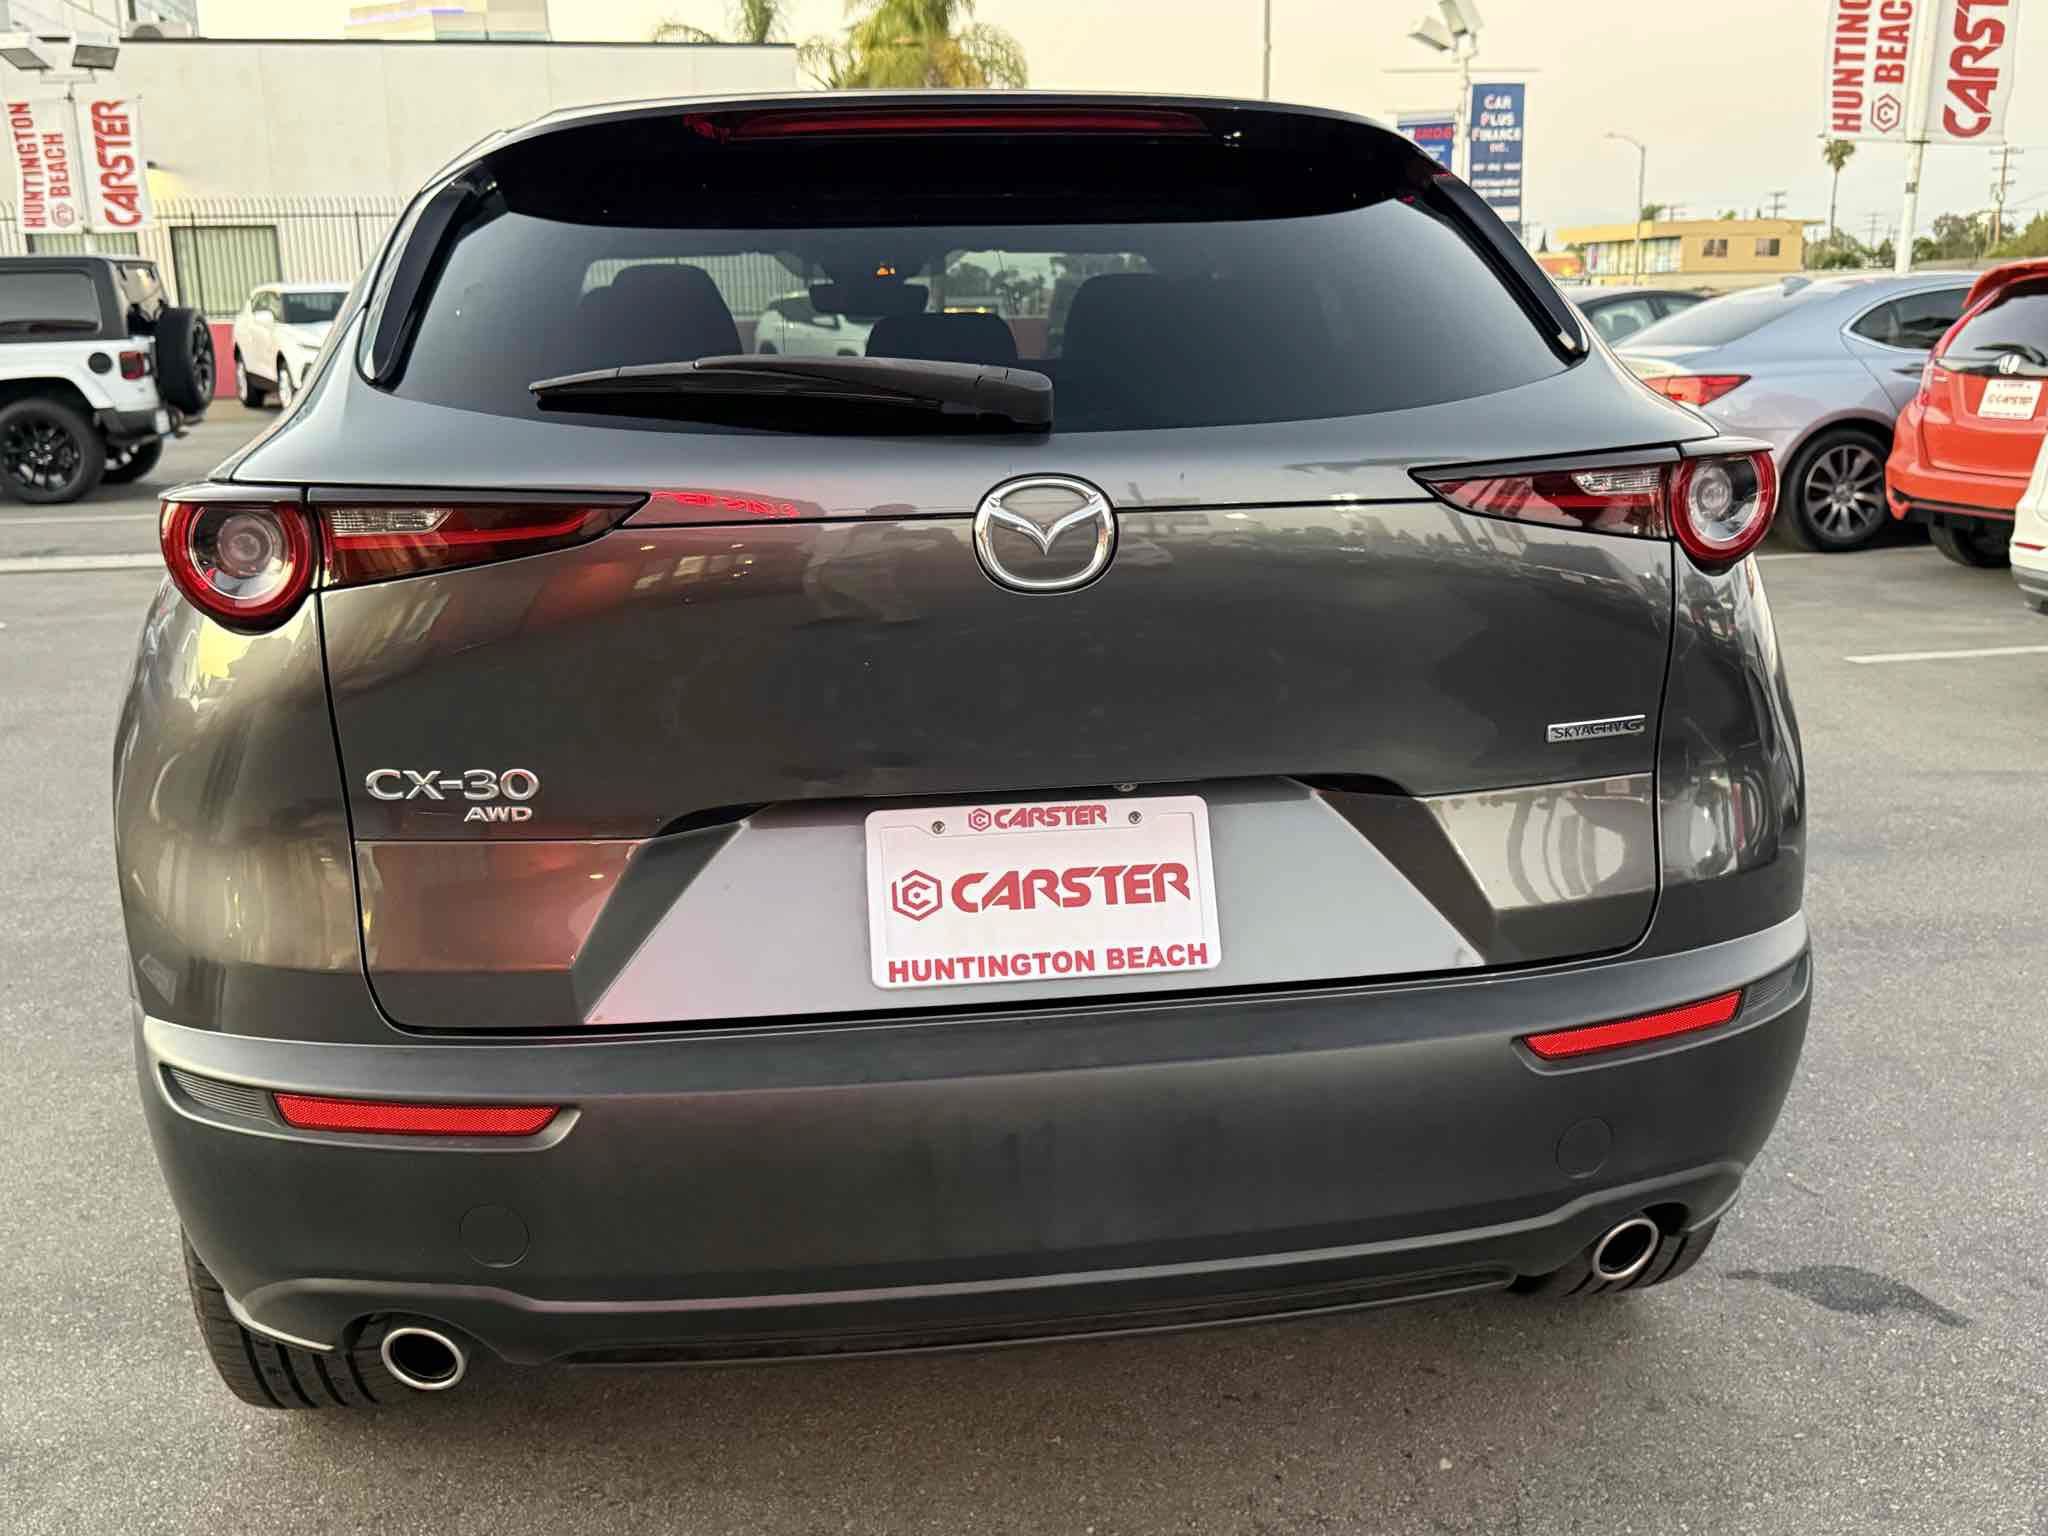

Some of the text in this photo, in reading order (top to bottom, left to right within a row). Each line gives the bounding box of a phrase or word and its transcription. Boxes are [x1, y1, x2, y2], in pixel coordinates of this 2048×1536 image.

[1480, 111, 1516, 127] PLUS
[1483, 95, 1512, 110] CAR
[7, 102, 46, 228] HUNTINGTON
[42, 132, 71, 198] BEACH
[91, 100, 143, 227] CARSTER
[365, 768, 541, 801] CX-30
[463, 806, 533, 823] AWD
[993, 804, 1108, 830] CARSTER
[950, 862, 1192, 913] CARSTER
[887, 942, 1209, 984] HUNTINGTON BEACH
